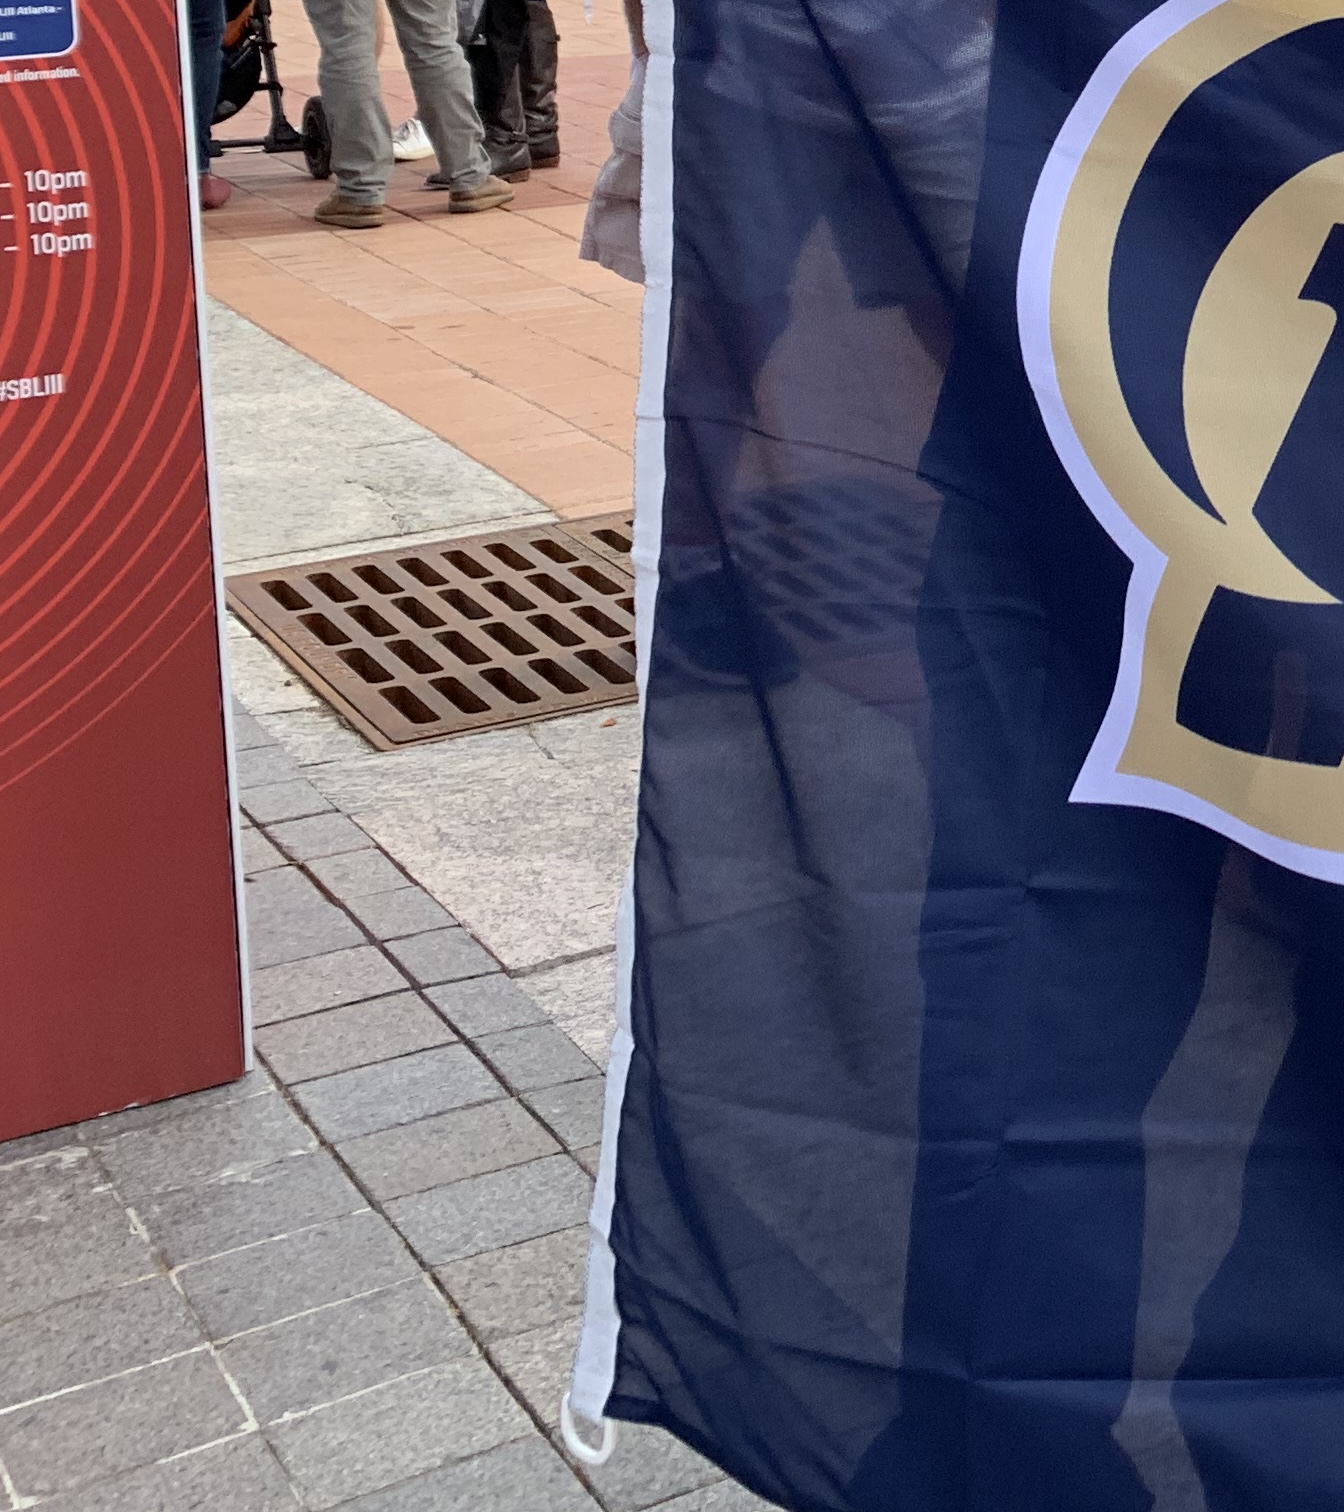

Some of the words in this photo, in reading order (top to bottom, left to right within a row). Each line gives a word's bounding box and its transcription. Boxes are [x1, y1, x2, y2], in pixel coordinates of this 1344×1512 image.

[16, 4, 56, 16] Atlanta
[24, 169, 88, 196] 10pm
[26, 200, 91, 227] 10pm
[30, 232, 94, 258] 10pm
